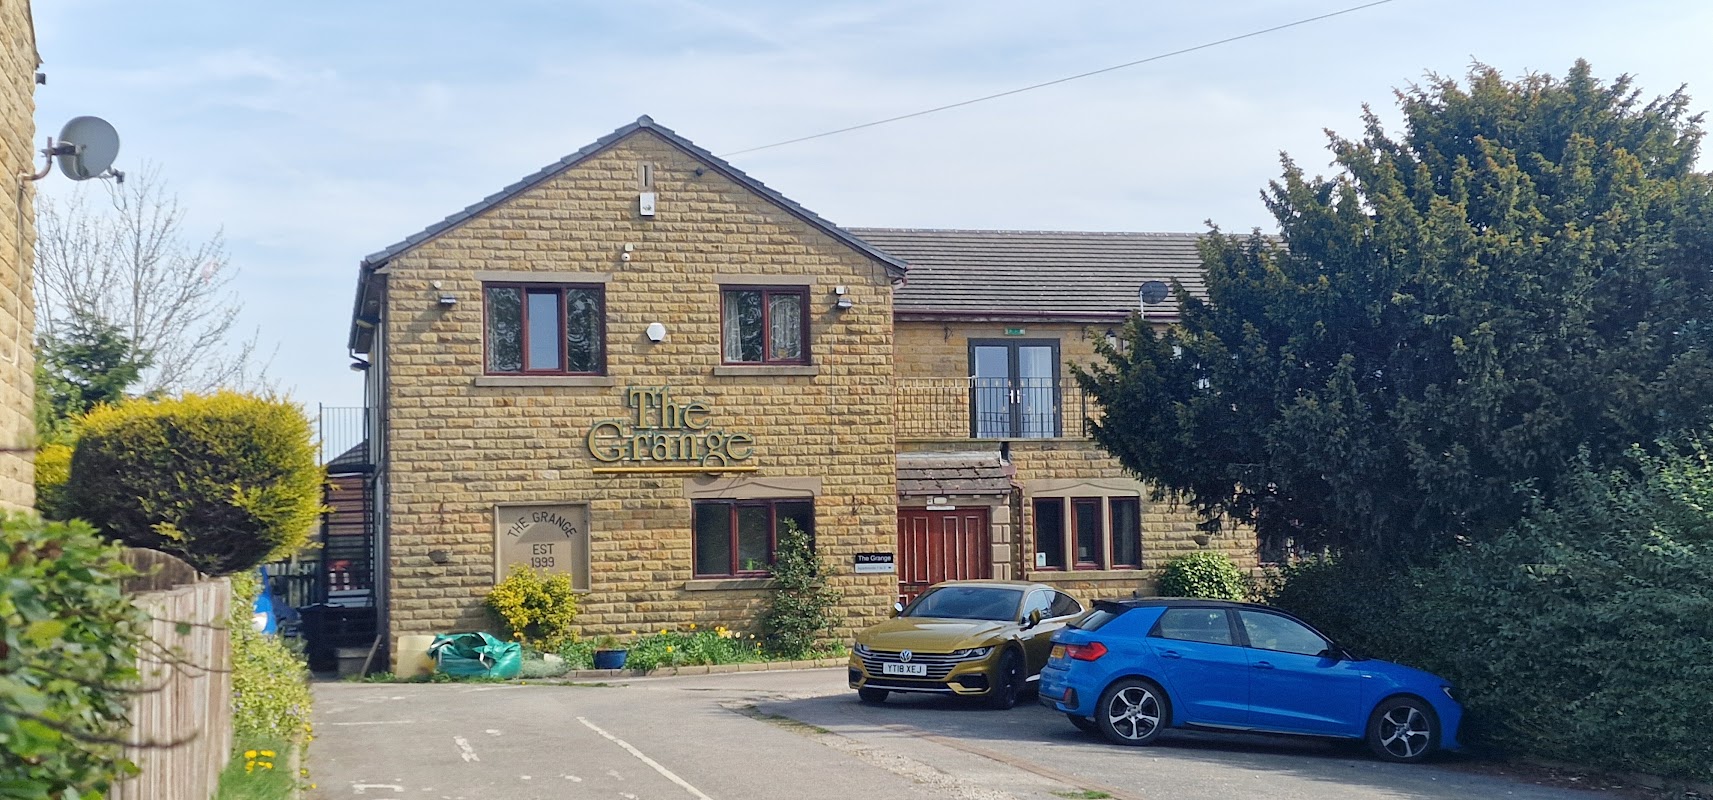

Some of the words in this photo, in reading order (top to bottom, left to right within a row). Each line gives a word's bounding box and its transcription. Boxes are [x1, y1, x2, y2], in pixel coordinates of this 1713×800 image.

[629, 385, 712, 431] The
[587, 419, 754, 476] Grange
[507, 516, 530, 538] THE
[532, 511, 578, 538] GRANGE
[532, 543, 555, 555] EST
[530, 556, 555, 568] 1999
[870, 555, 892, 563] Grange
[887, 664, 905, 673] YT18
[906, 665, 922, 674] XEJ
